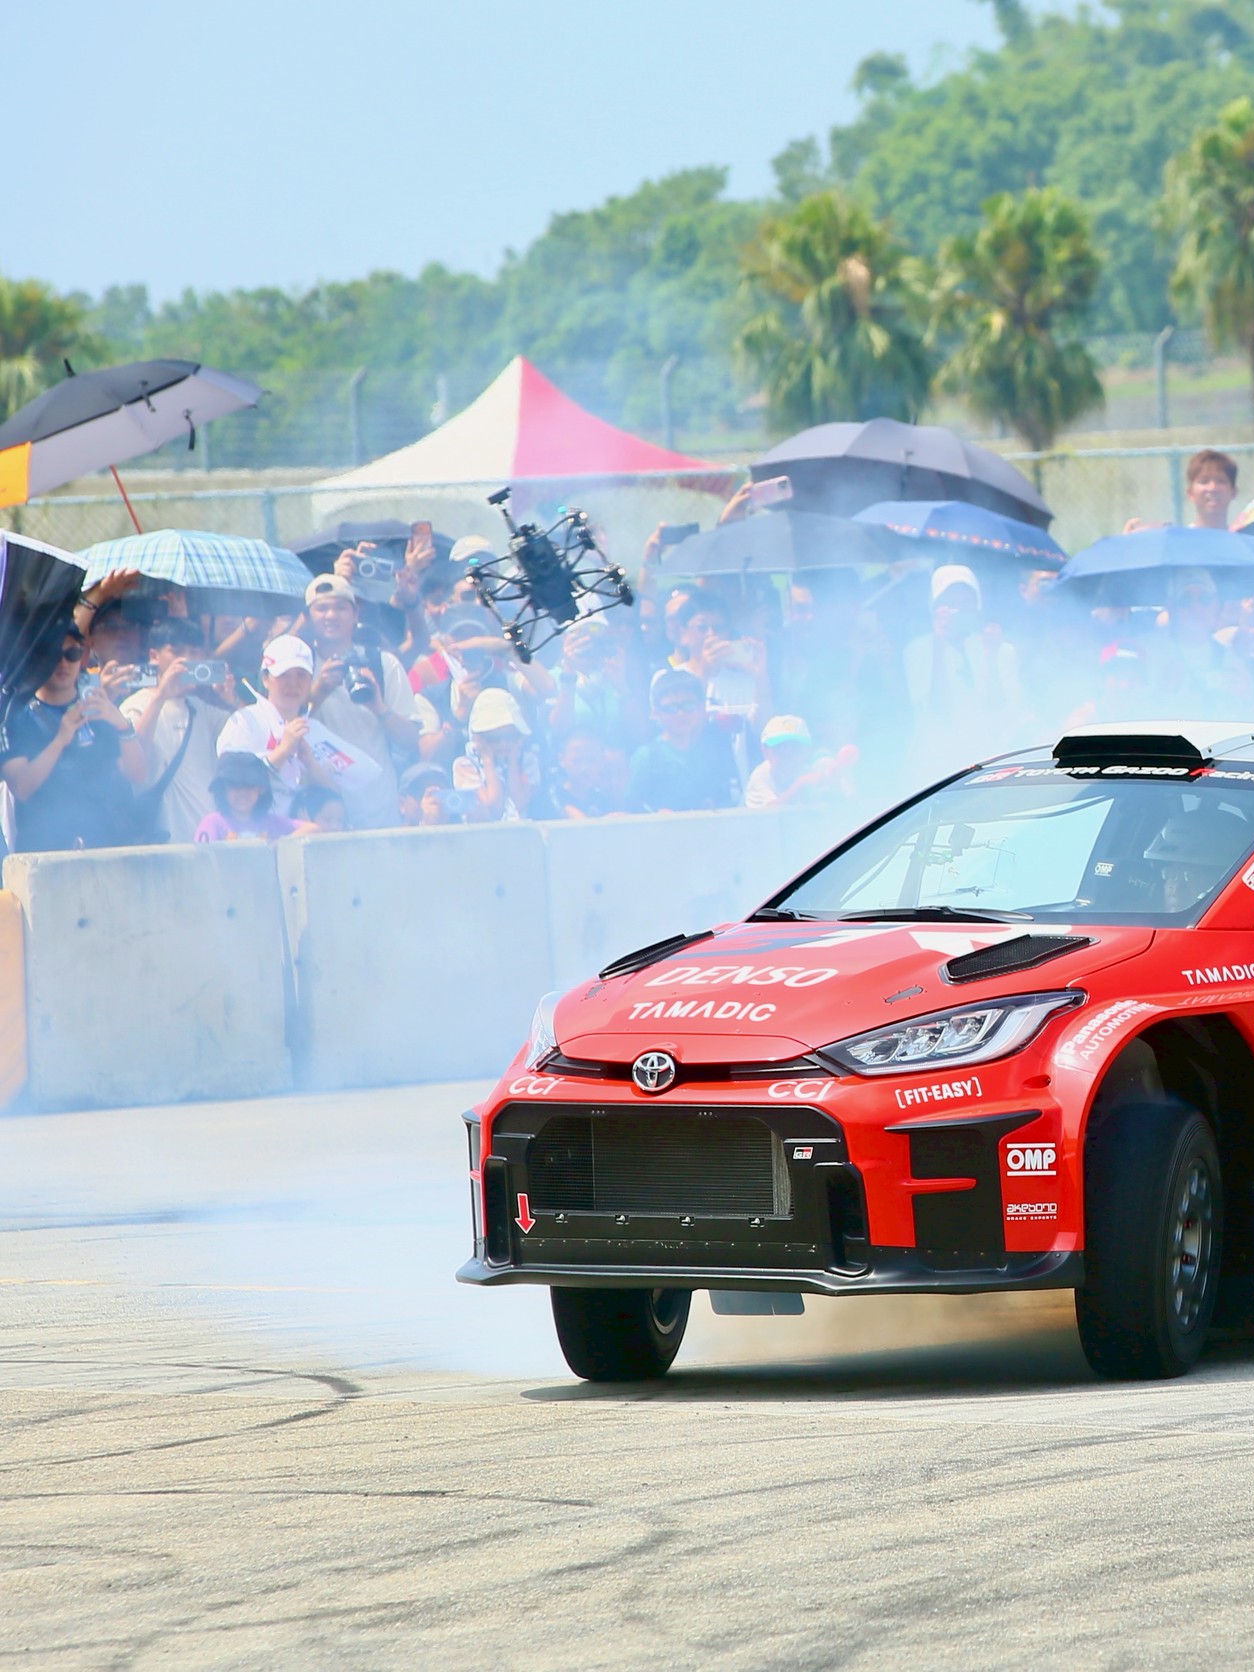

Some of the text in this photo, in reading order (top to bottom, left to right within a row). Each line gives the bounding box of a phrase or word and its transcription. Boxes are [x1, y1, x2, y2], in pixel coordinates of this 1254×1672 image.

[1014, 766, 1099, 777] TOYOTA
[1101, 765, 1189, 777] GAZOO
[643, 966, 839, 988] DENSO
[627, 1000, 776, 1023] TAMADIC
[1006, 1148, 1057, 1170] OMP
